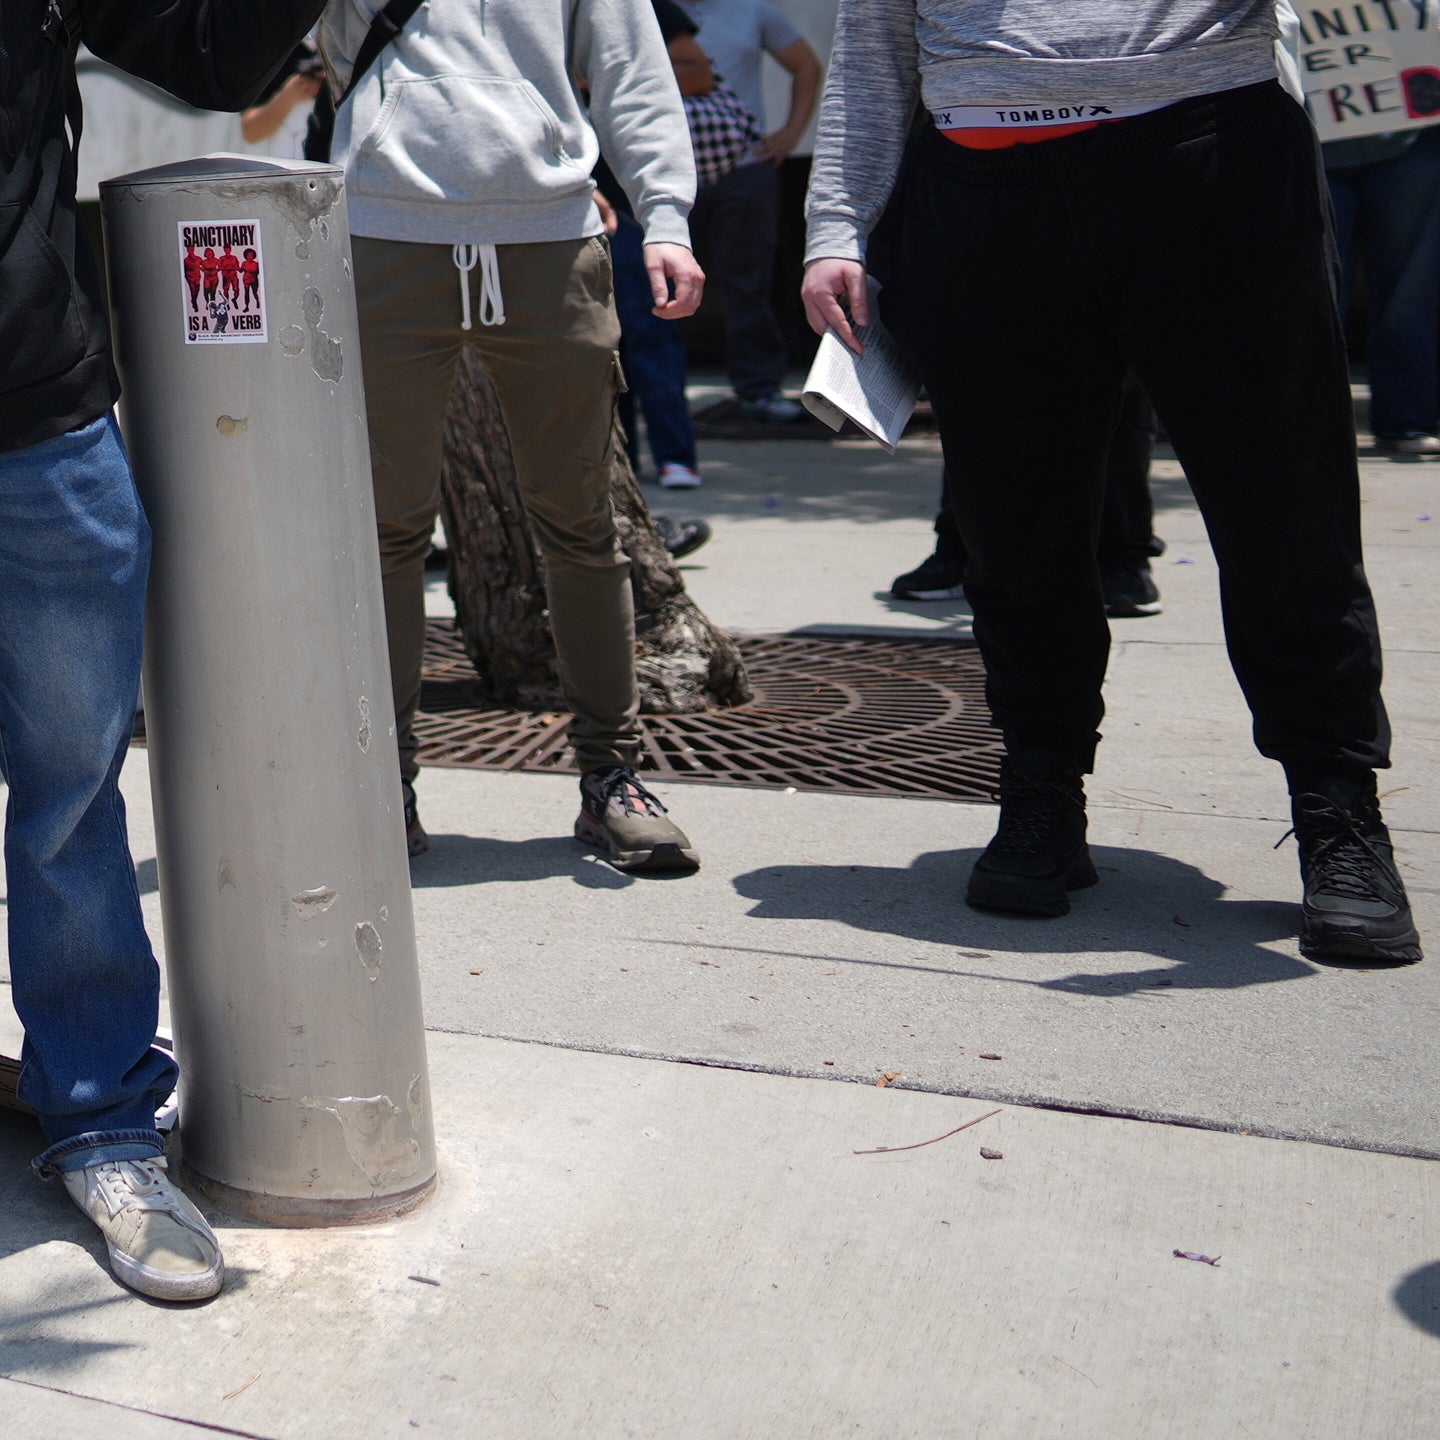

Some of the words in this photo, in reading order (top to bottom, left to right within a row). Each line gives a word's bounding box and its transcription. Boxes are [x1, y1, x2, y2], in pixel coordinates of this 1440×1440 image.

[1303, 44, 1391, 72] ER
[183, 225, 255, 247] SANCTUARY
[189, 316, 200, 331] IS
[202, 316, 209, 330] A
[232, 315, 261, 330] VERB
